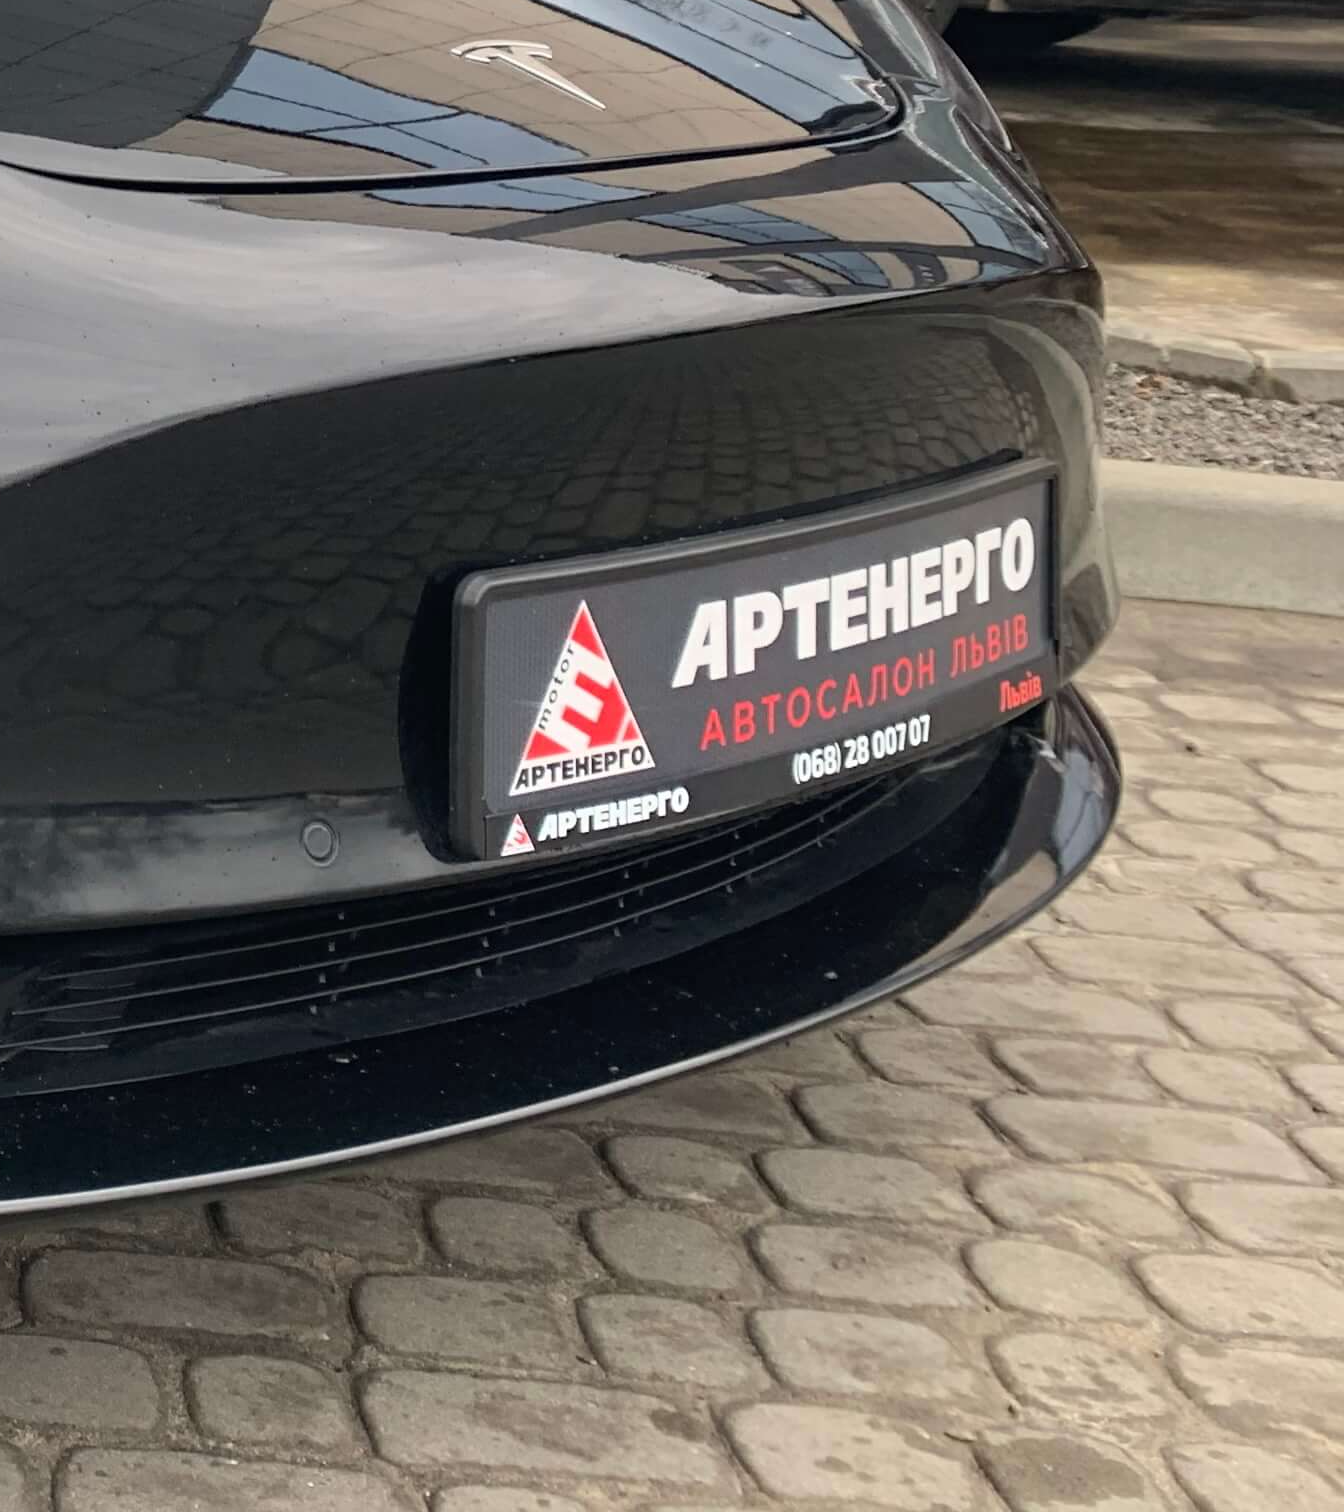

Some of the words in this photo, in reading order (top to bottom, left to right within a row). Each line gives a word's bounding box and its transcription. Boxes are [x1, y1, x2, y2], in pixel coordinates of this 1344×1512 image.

[672, 518, 1035, 688] АРТЕНЕРГО
[539, 644, 574, 730] motor
[700, 648, 935, 752] АВТОСАЛОН
[949, 614, 1029, 679] ЛЬВІВ
[999, 670, 1043, 712] Львів
[515, 746, 645, 790] АРТЕНЕРГО
[793, 742, 842, 784] (068)
[844, 735, 869, 769] 28
[538, 787, 690, 842] АРТЕНЕРГО
